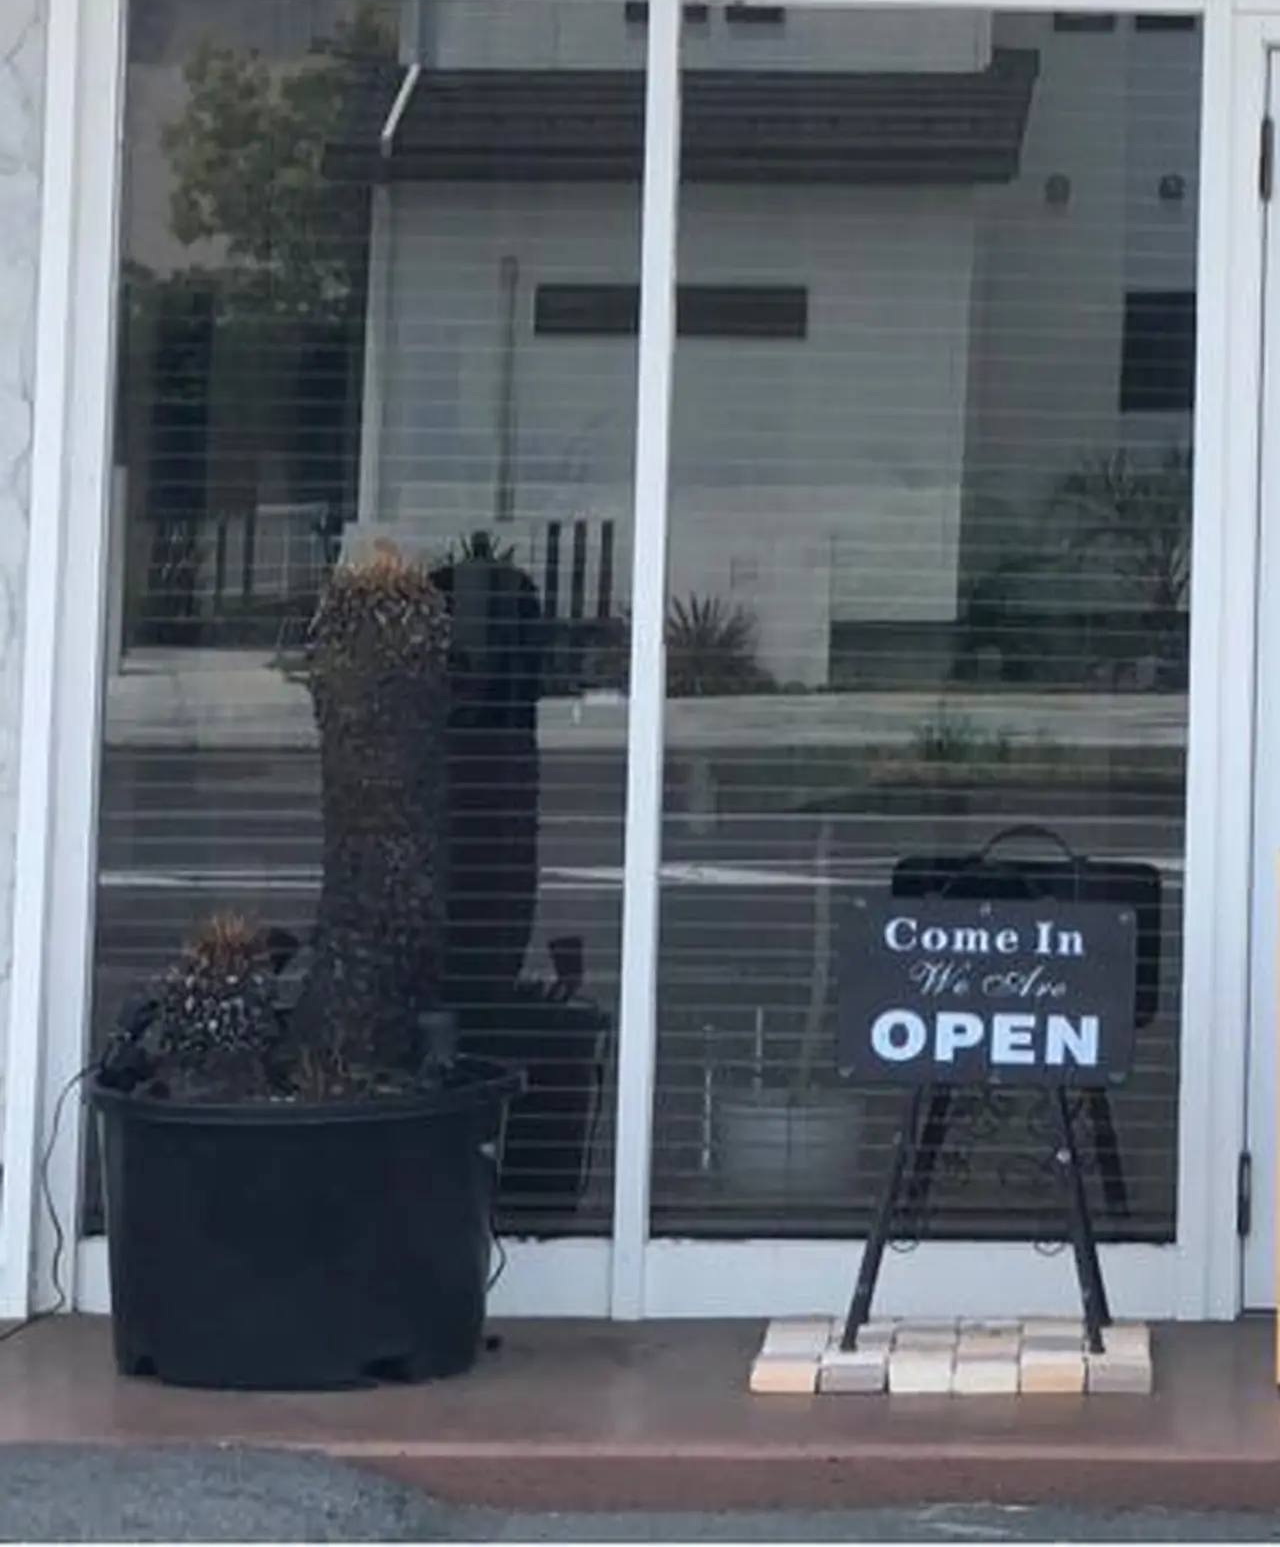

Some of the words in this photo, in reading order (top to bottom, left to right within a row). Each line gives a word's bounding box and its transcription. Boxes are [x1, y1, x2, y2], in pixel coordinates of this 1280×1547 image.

[884, 917, 1020, 953] Come
[1034, 921, 1085, 955] In
[909, 959, 972, 996] We
[870, 1008, 1099, 1065] OPEN
